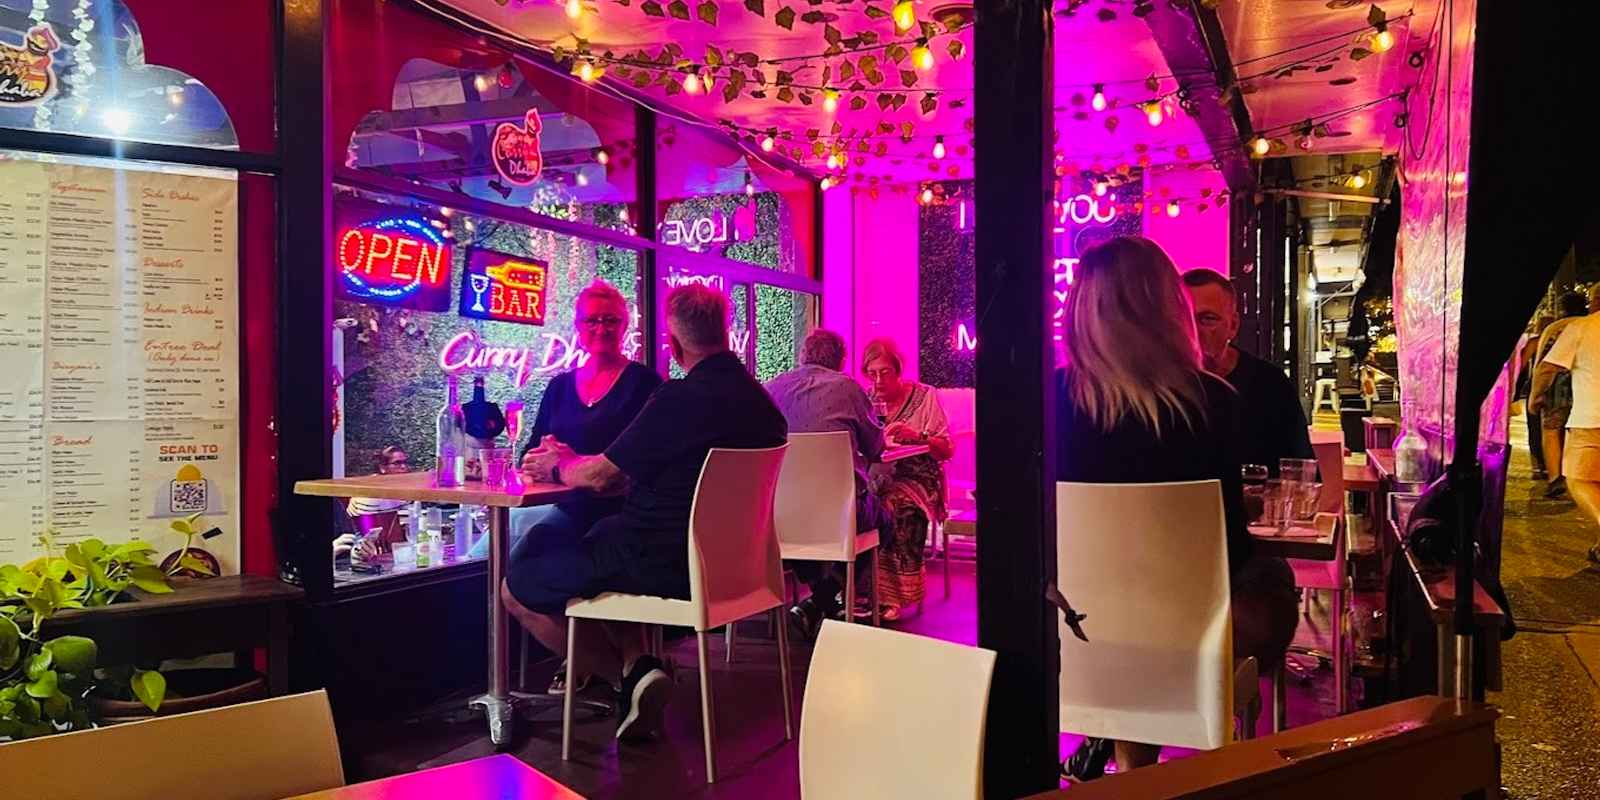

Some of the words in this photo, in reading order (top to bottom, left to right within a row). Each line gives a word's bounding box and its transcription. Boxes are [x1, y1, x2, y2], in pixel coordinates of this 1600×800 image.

[0, 79, 42, 97] haba
[339, 229, 445, 285] OPEN
[489, 283, 542, 319] BAR
[440, 332, 530, 389] Curry
[52, 436, 93, 447] Bread
[159, 445, 197, 455] SCAN
[201, 444, 219, 454] TO
[194, 454, 219, 462] MENU
